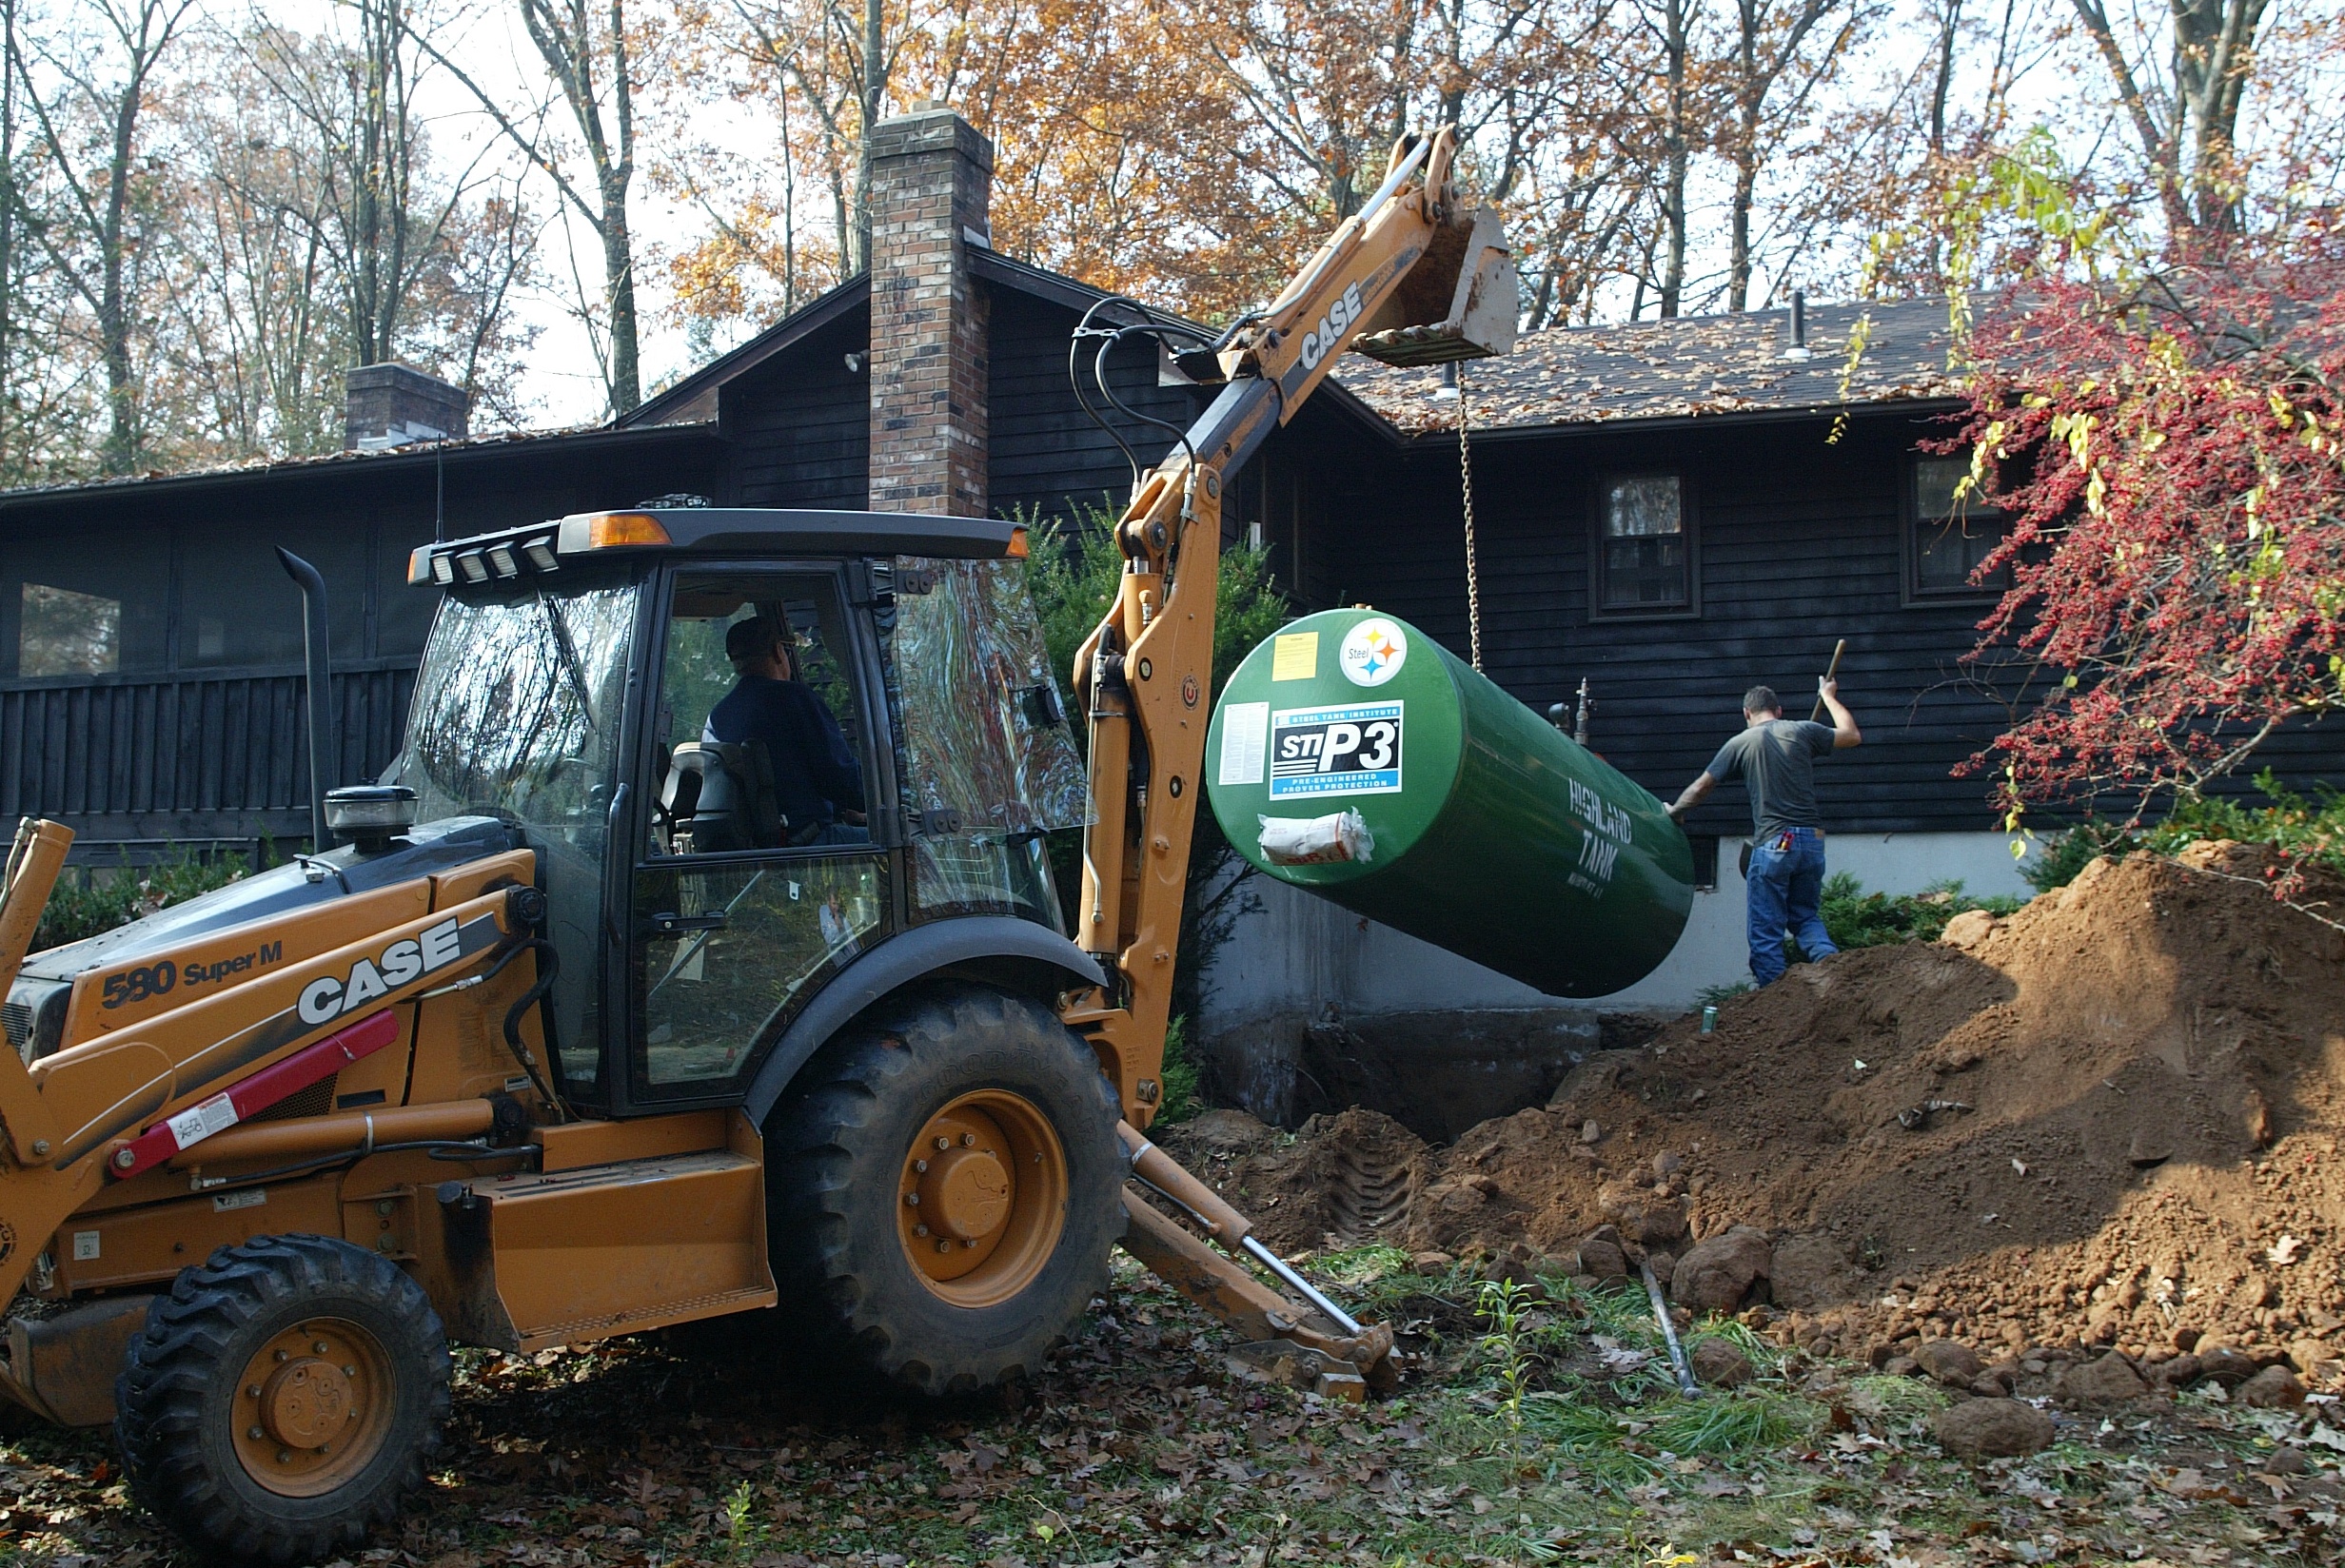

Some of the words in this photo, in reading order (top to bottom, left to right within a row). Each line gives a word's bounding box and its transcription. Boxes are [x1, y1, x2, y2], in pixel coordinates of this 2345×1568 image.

[1301, 281, 1362, 370] CASE
[1348, 647, 1370, 659] Steel
[1292, 715, 1319, 723] STEEL
[1323, 712, 1345, 720] TANK
[1350, 708, 1398, 718] INSTITUTE
[1282, 783, 1321, 794] PROVEN
[1324, 779, 1388, 790] PROTECTION
[1292, 774, 1377, 785] PRE-ENGINEERED
[1568, 777, 1632, 845] HIGHLAND
[1578, 829, 1619, 882] TANK
[184, 952, 256, 986] Super
[260, 940, 283, 965] M
[297, 916, 461, 1025] CASE
